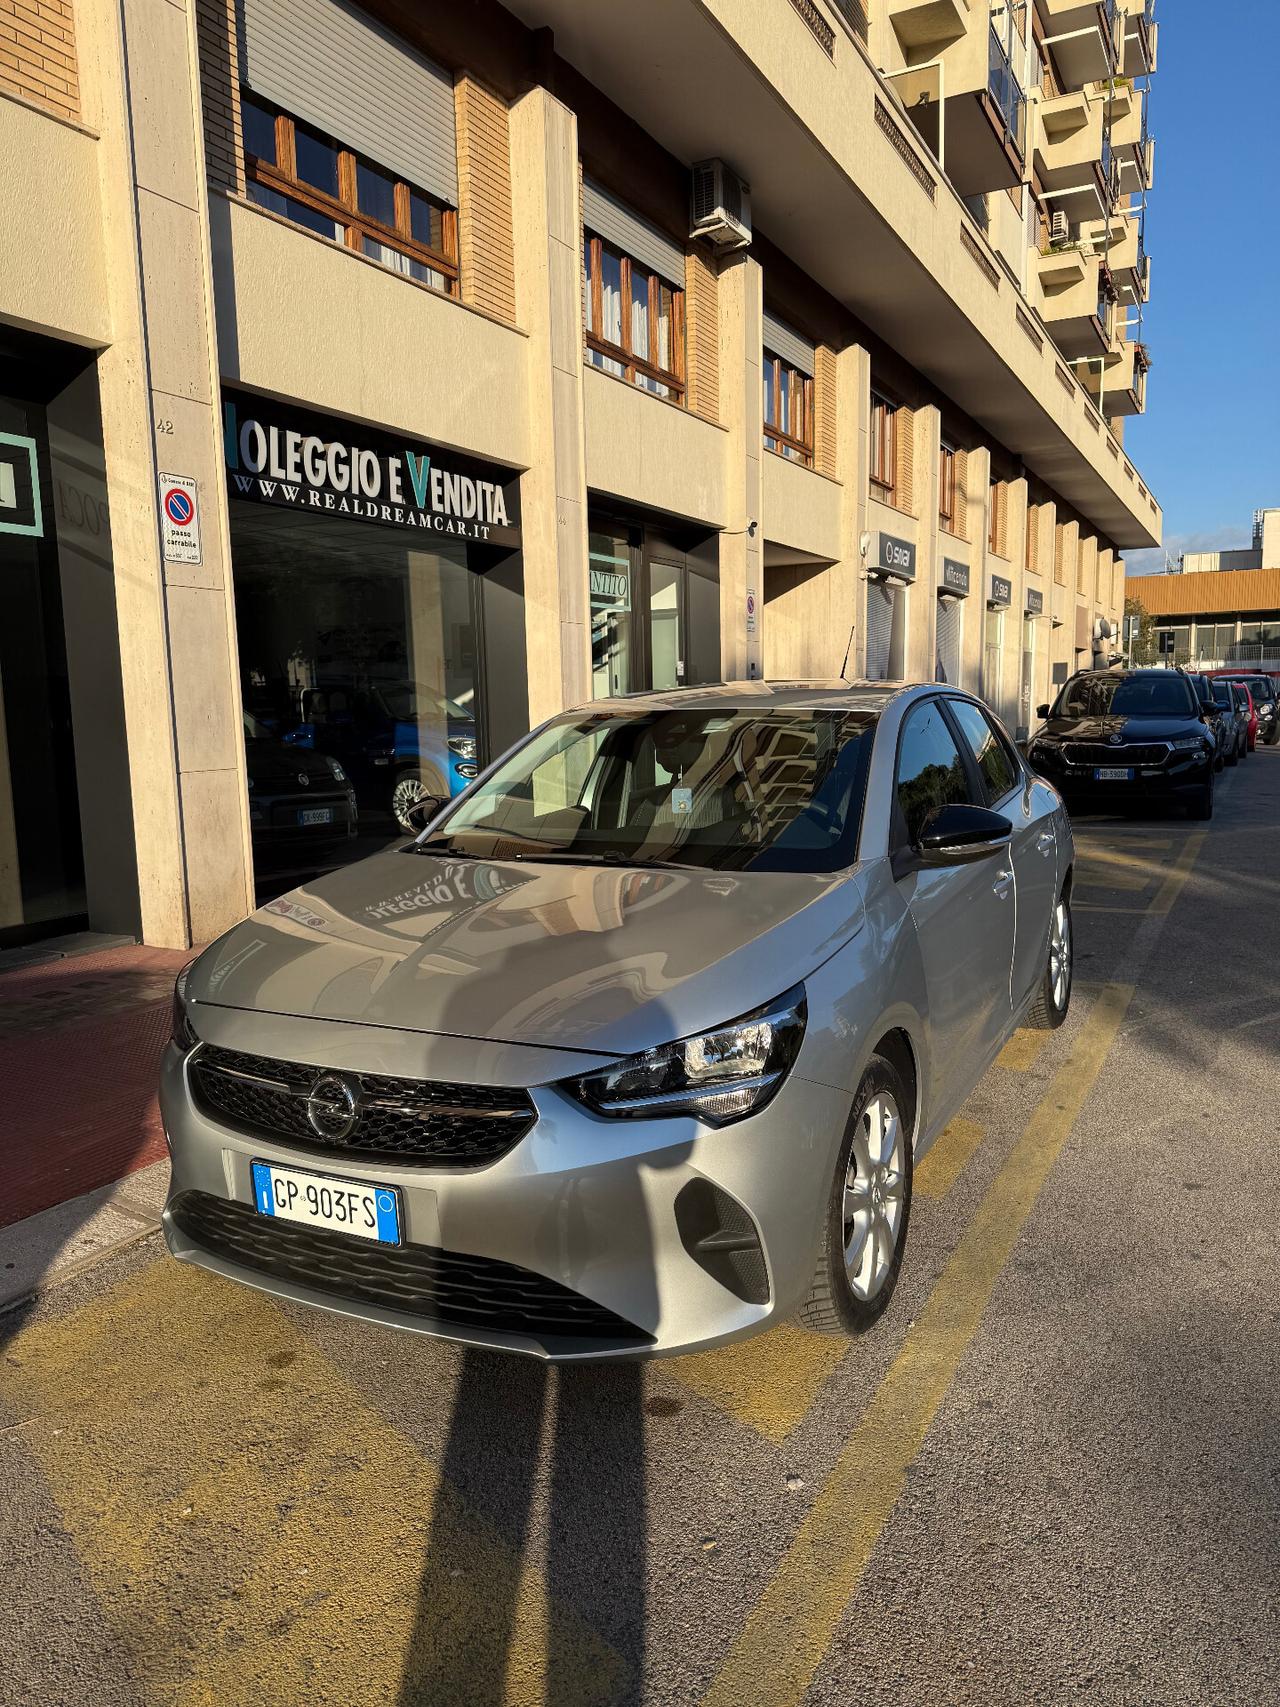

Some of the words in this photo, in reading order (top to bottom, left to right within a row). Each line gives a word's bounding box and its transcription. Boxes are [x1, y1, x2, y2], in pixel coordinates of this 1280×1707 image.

[156, 418, 174, 435] 42
[389, 456, 403, 504] E
[405, 450, 509, 527] VENDITA
[232, 473, 490, 540] WWW.REALDREAMCAR.IT
[166, 539, 197, 548] carrabile
[171, 529, 191, 538] passo
[590, 570, 627, 596] NTITO
[274, 1178, 298, 1211] GP
[306, 1185, 376, 1228] 903FS
